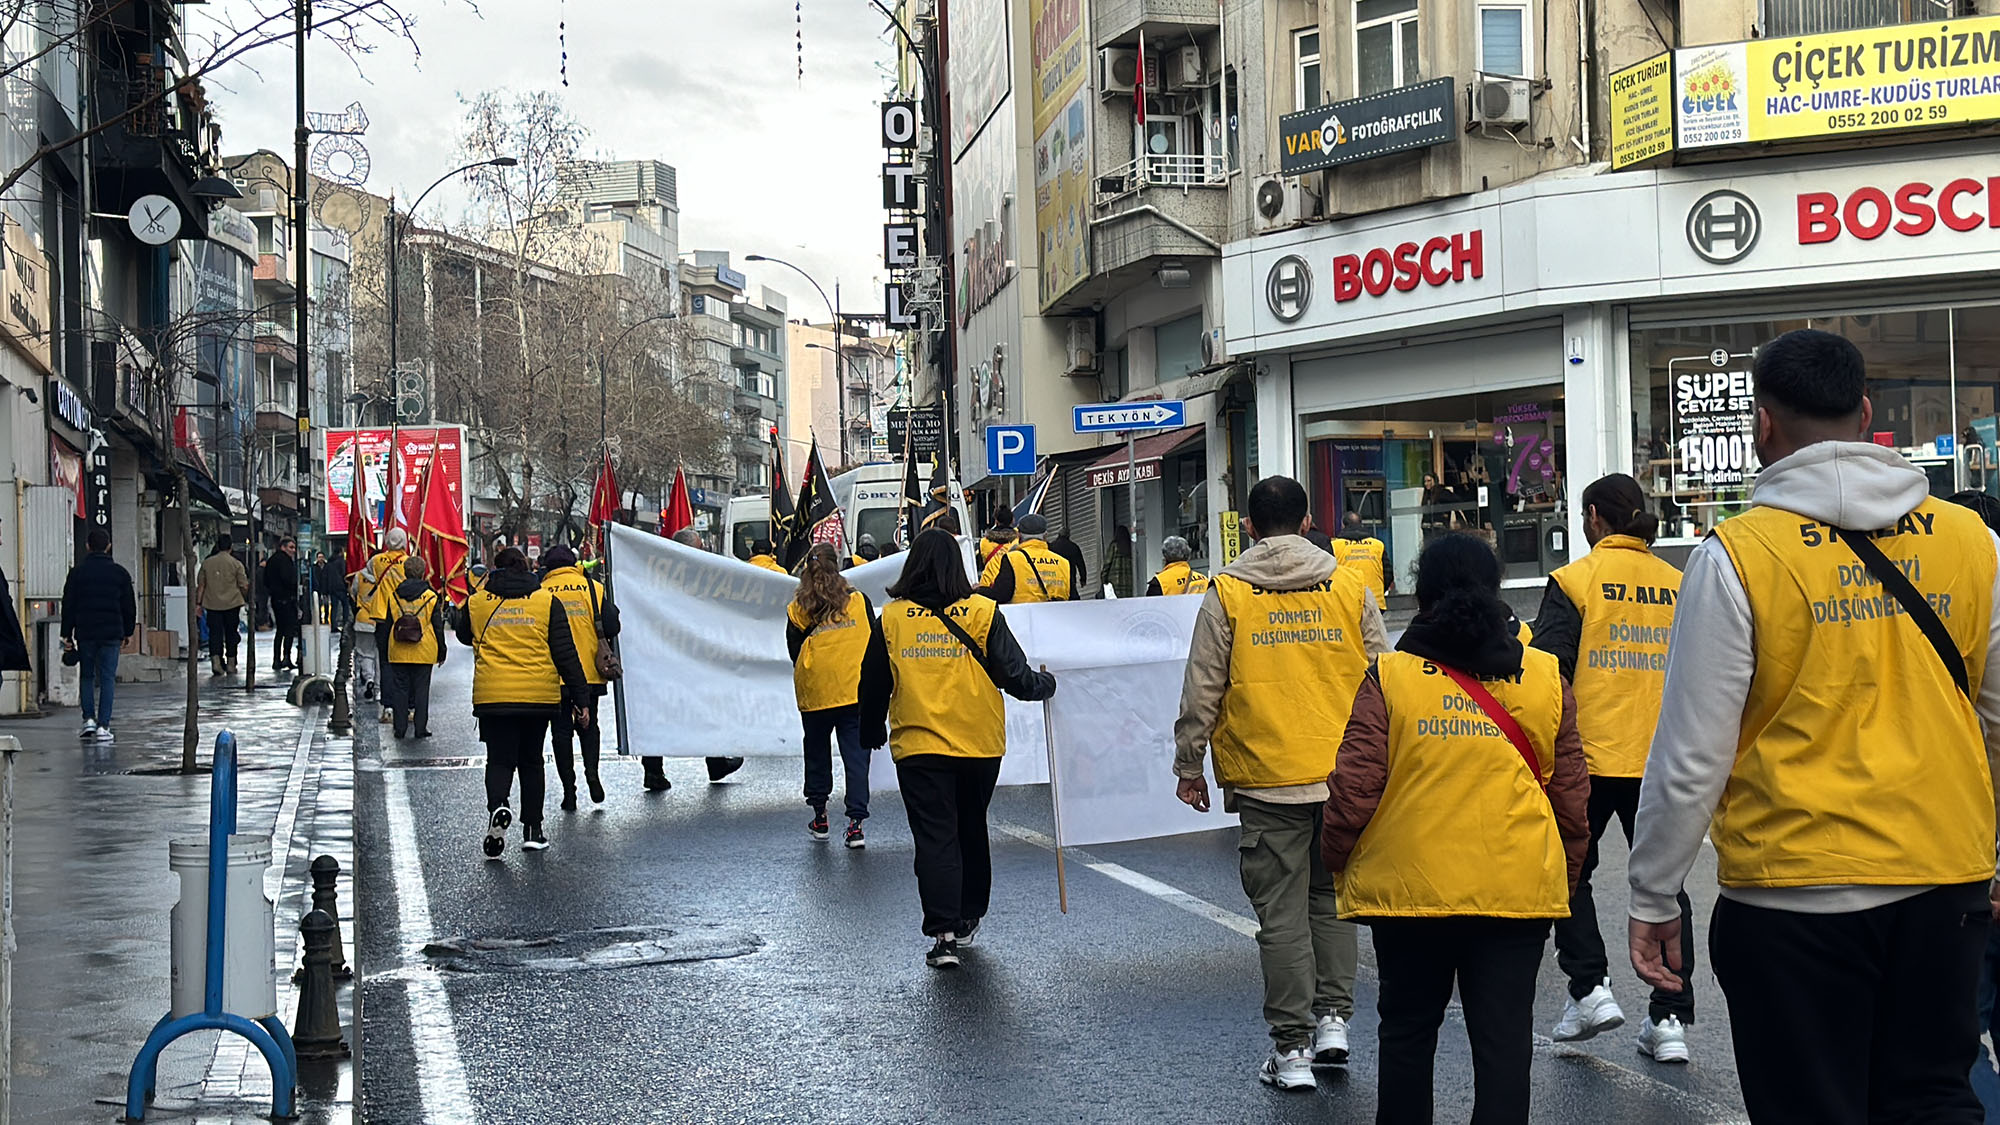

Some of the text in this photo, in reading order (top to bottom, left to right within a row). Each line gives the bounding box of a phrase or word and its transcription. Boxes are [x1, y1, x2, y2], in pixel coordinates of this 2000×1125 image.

[1772, 41, 1866, 92] ÇİÇEK
[1873, 25, 2000, 74] TURİZM
[1613, 75, 1637, 96] ÇİÇEK
[1637, 61, 1668, 84] TURİZM
[1766, 78, 1931, 116] HAC-UMRE-KUDÜS
[1828, 104, 1948, 129] 0552 200 02 59
[1286, 107, 1443, 156] VAROL FOTOĞRAFÇILIK
[1684, 128, 1742, 144] 0552 200 02 59
[1620, 141, 1666, 165] 0552 200 02 59
[885, 106, 917, 324] OTEL
[1333, 229, 1484, 303] BOSCH
[1087, 410, 1151, 425] TEK YÖN
[997, 430, 1026, 470] P
[1679, 434, 1755, 472] 15000T
[1093, 464, 1154, 487] DEXİS AYAKABI
[1704, 468, 1742, 483] indirim
[1031, 557, 1059, 566] 7.ALAY
[1268, 606, 1323, 625] DÖNMEYİ
[1251, 627, 1343, 648] DÜŞÜNMEDİLER
[1588, 645, 1667, 674] DÜŞÜNMED
